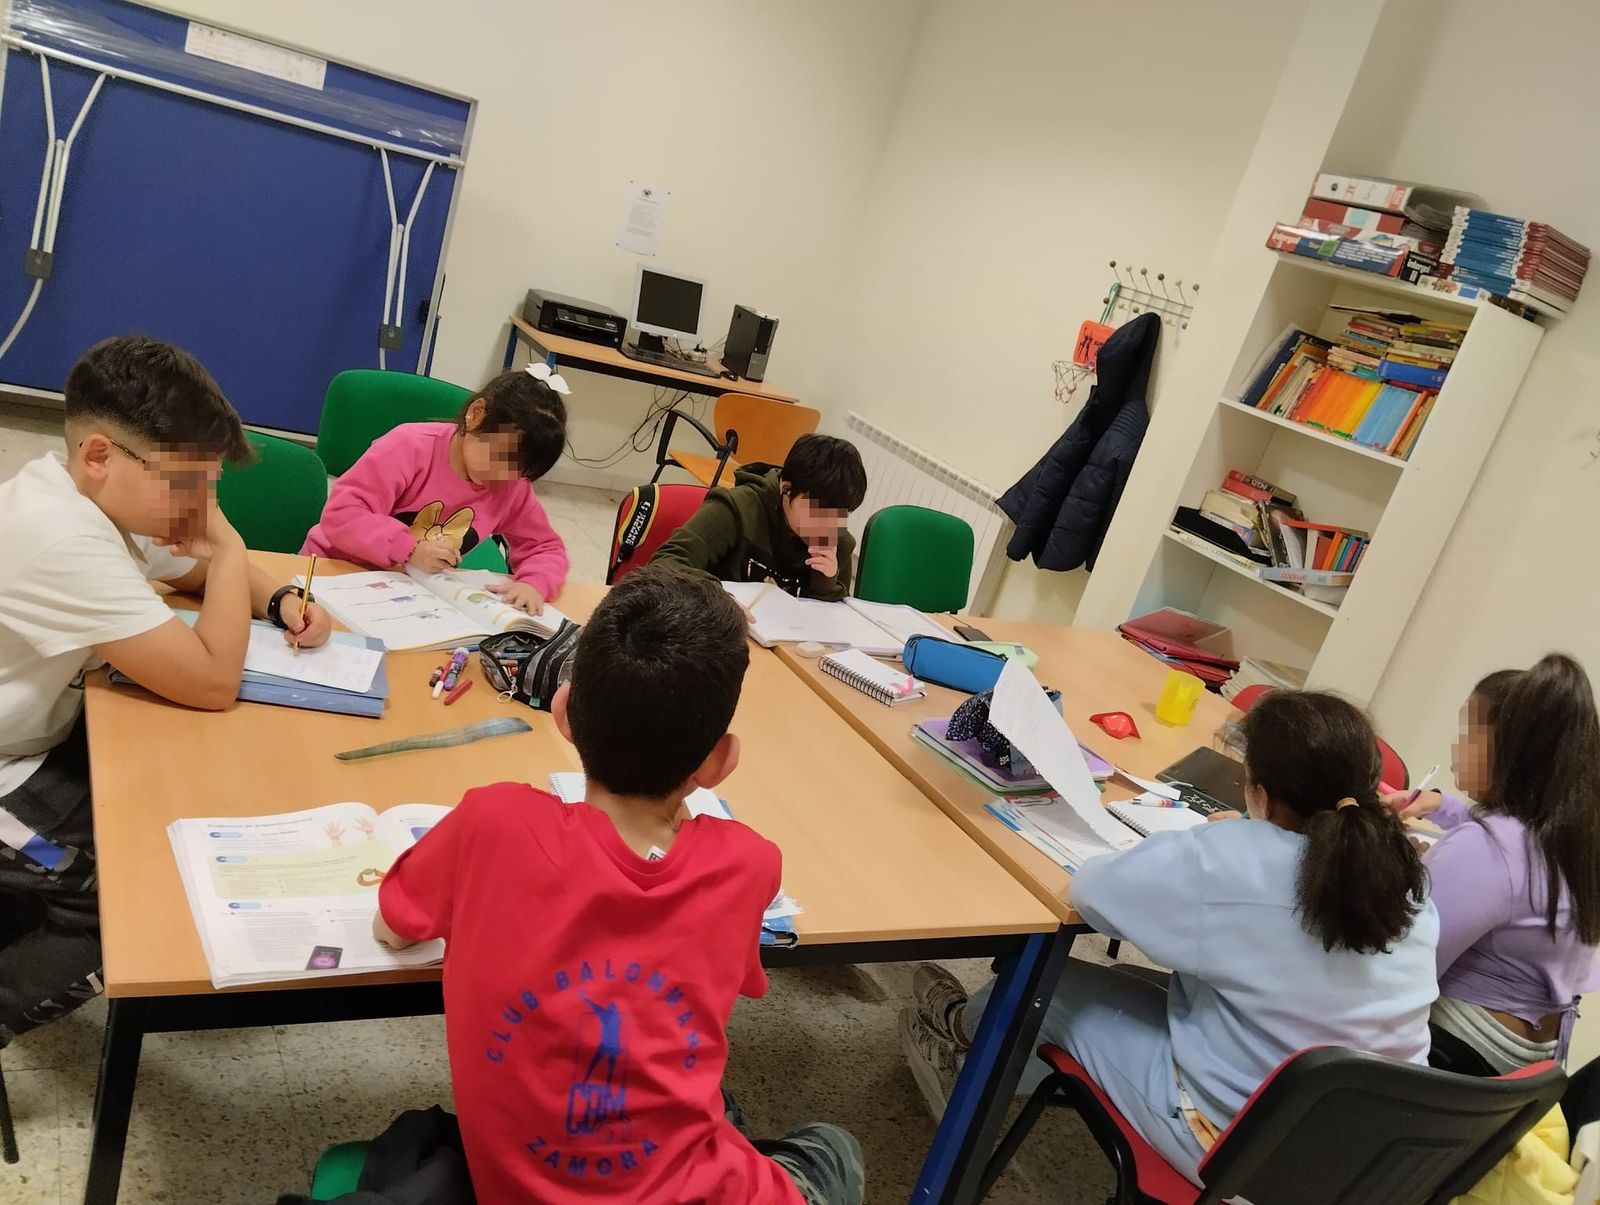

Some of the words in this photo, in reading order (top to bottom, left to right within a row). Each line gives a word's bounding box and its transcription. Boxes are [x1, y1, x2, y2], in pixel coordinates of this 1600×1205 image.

[485, 990, 540, 1063] CLUB
[555, 959, 701, 1070] BALONMANO
[526, 1136, 659, 1177] ZAMORA
